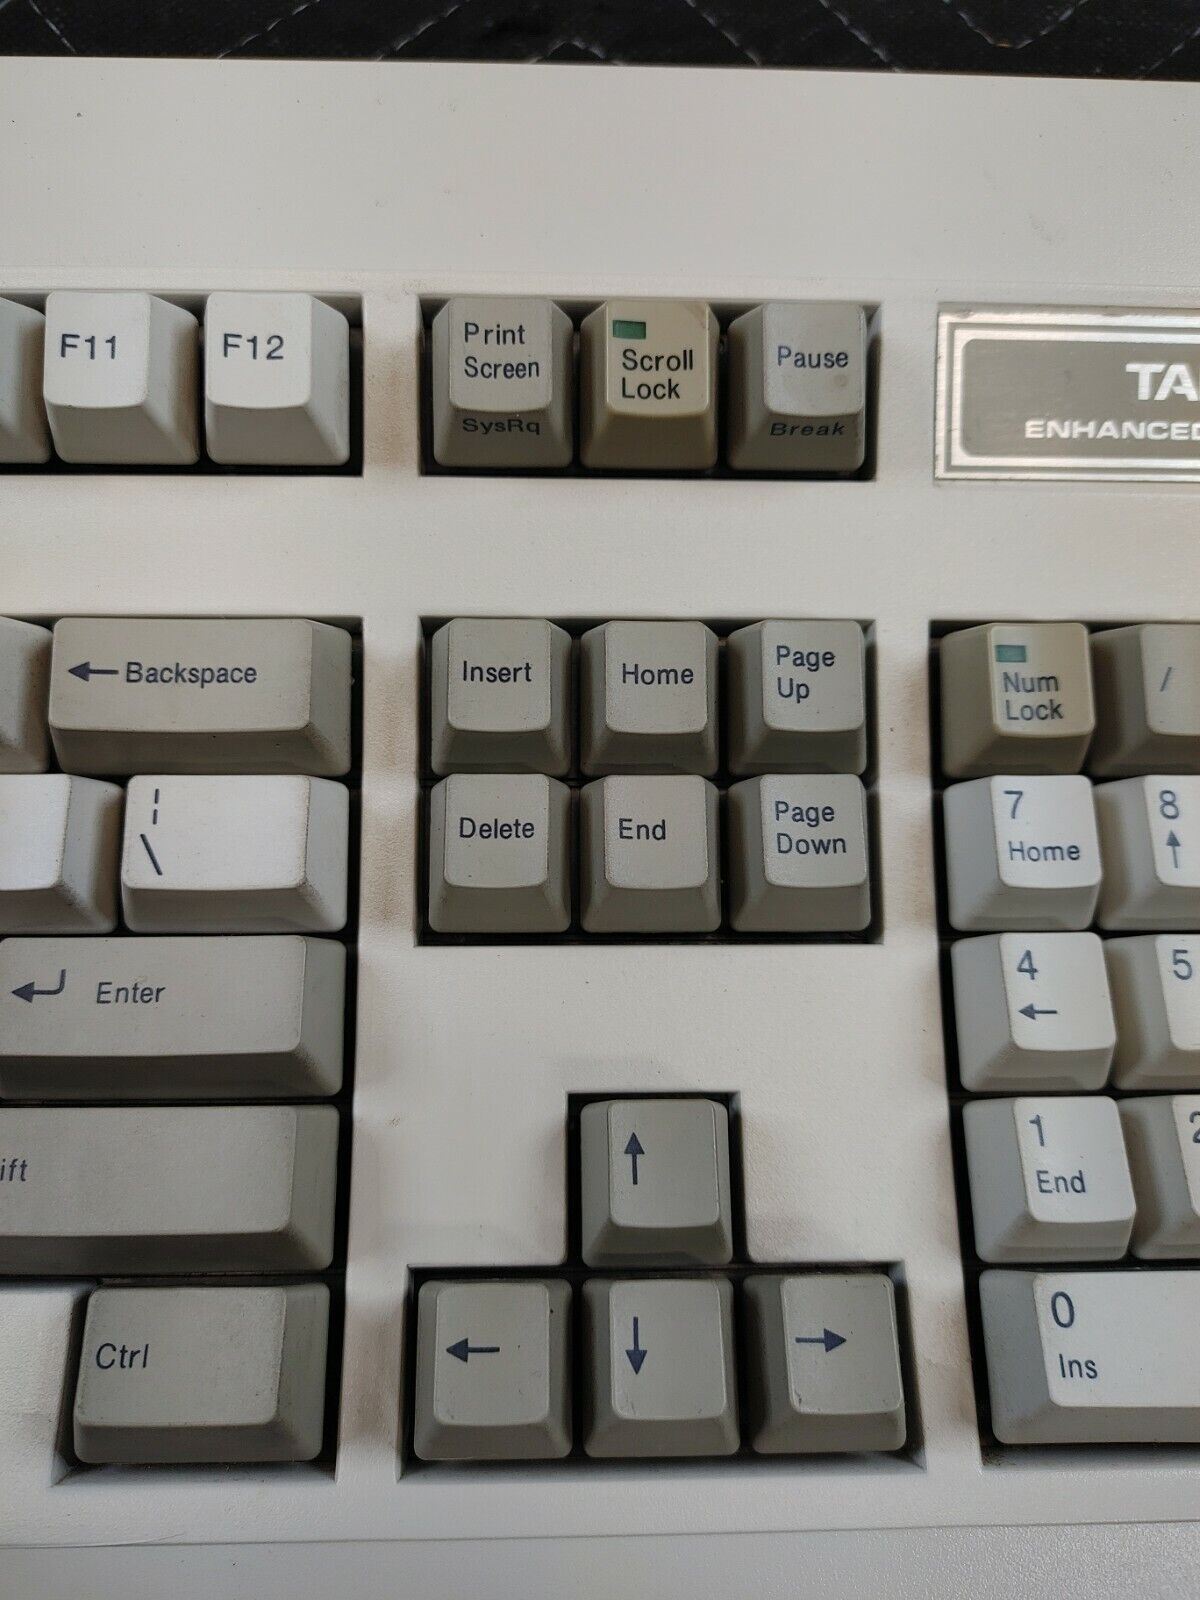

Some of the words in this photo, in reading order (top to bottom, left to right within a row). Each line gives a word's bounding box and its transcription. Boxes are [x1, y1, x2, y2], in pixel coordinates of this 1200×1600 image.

[223, 332, 284, 360] F12
[464, 321, 526, 346] Print
[60, 333, 116, 360] F11
[777, 345, 849, 369] Pause
[464, 355, 540, 380] Screen
[622, 348, 694, 372] Scroll
[621, 376, 681, 400] Lock
[462, 417, 540, 436] SysRq
[770, 421, 845, 436] Break
[776, 645, 836, 673] Page
[125, 661, 257, 689] Backspace
[462, 660, 532, 684] Insert
[622, 662, 694, 686] Home
[1003, 672, 1059, 694] Num
[777, 676, 810, 704] Up
[1007, 698, 1064, 721] Lock
[775, 800, 835, 827] Page
[1003, 790, 1024, 820] 7
[1159, 789, 1180, 820] 8
[459, 816, 535, 840] Delete
[618, 818, 666, 841] End
[776, 832, 847, 855] Down
[1008, 841, 1081, 862] Home
[1016, 949, 1039, 981] 4
[1172, 949, 1193, 981] 5
[96, 981, 166, 1005] Enter
[1029, 1114, 1045, 1147] 1
[1036, 1169, 1086, 1194] End
[1050, 1291, 1075, 1329] 0
[95, 1342, 149, 1370] Ctrl
[1058, 1353, 1098, 1380] Ins
